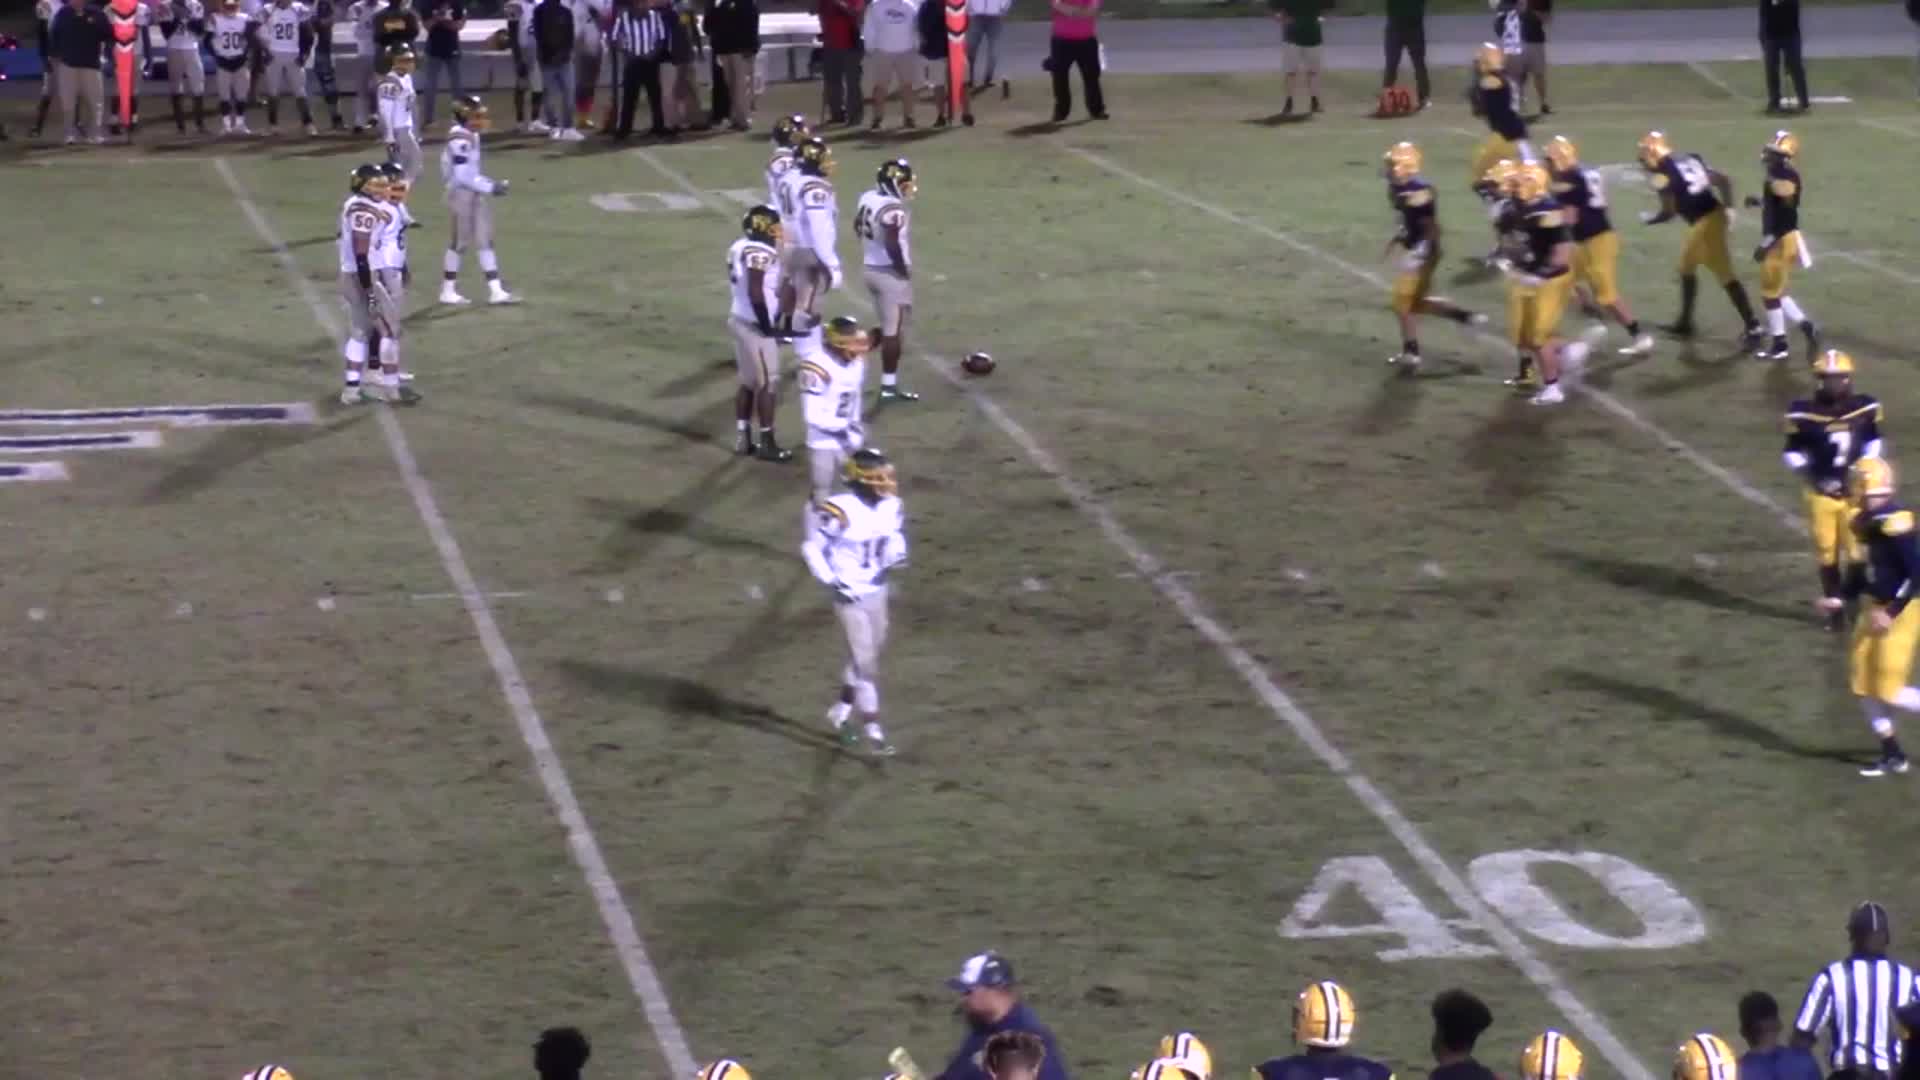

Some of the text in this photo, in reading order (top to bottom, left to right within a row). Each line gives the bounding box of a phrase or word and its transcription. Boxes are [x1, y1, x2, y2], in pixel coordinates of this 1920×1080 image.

[222, 31, 241, 50] 30
[273, 23, 294, 40] 20
[354, 214, 374, 229] 50
[1828, 431, 1851, 467] 7
[1279, 849, 1706, 962] 40
